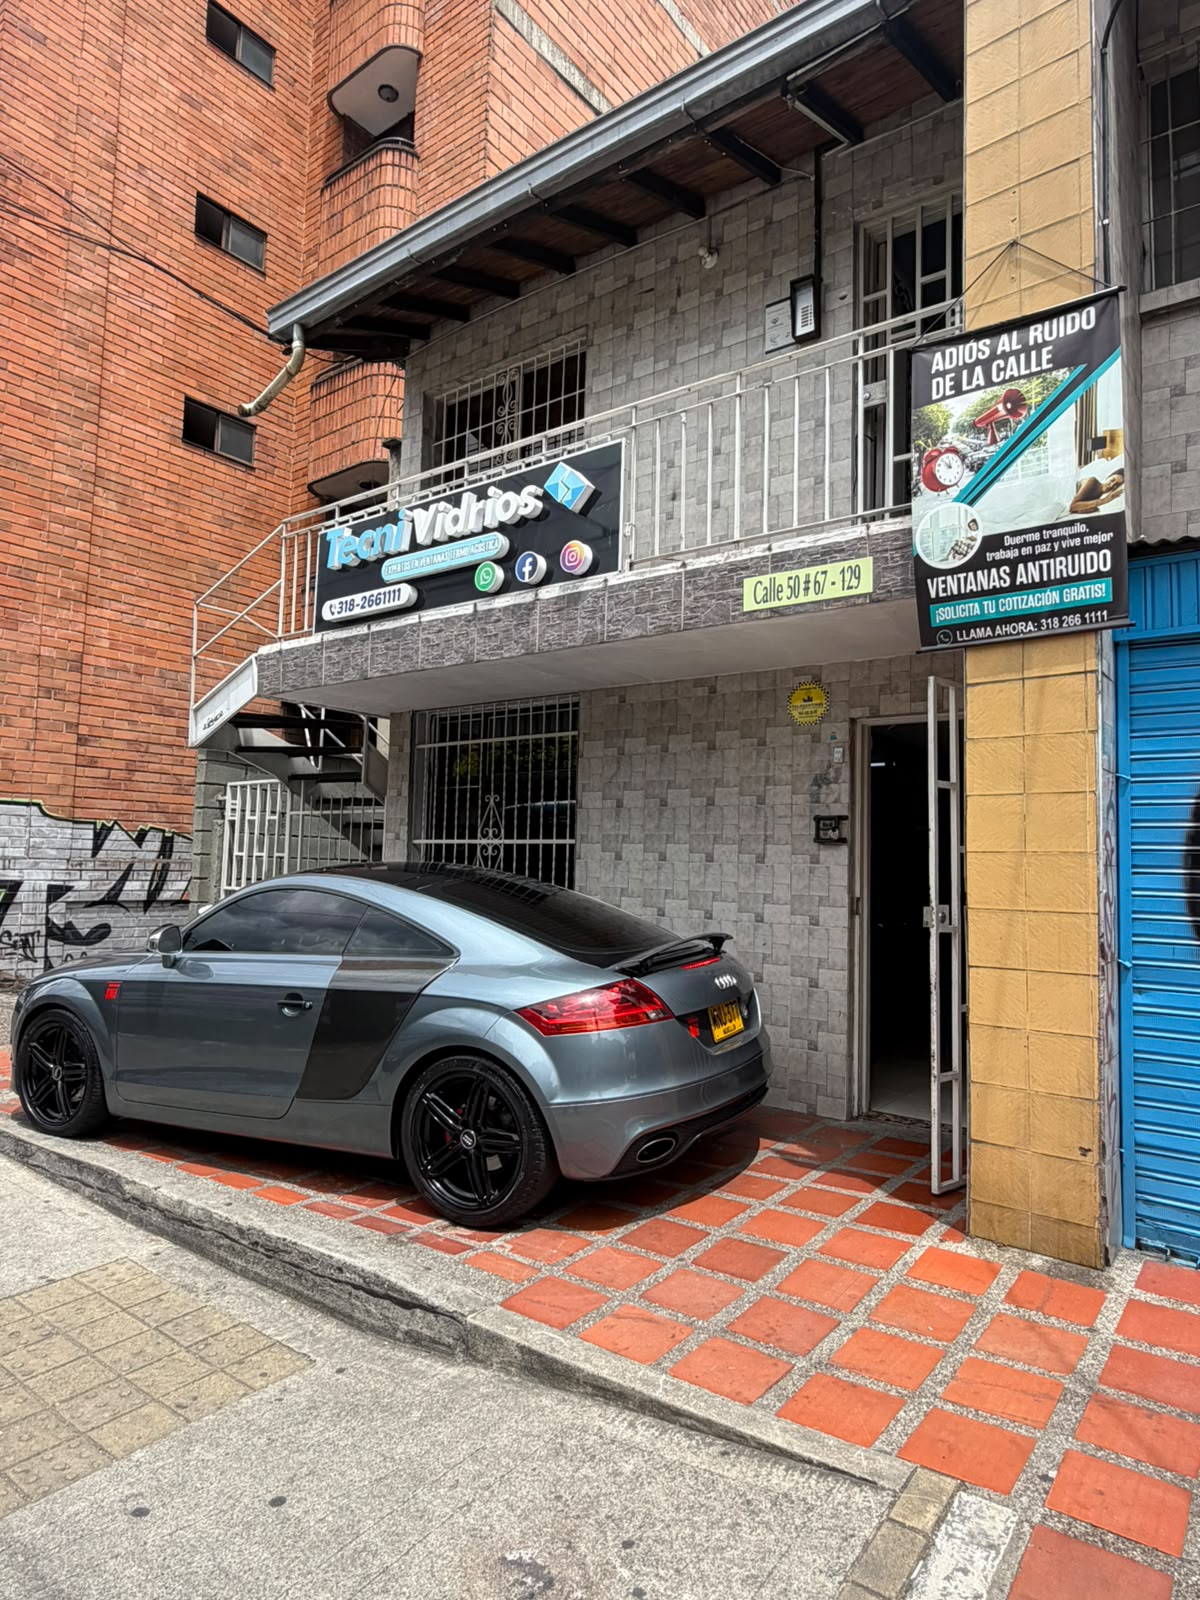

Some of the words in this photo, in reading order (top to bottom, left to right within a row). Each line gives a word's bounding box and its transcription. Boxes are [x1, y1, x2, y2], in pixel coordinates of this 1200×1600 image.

[996, 330, 1022, 355] AL
[1029, 306, 1096, 346] RUIDO
[931, 373, 956, 400] DE
[962, 365, 985, 391] LA
[991, 346, 1053, 383] CALLE
[986, 547, 1019, 562] trabaja
[1021, 545, 1032, 555] en
[1035, 542, 1051, 554] paz
[1054, 540, 1060, 552] y
[1061, 536, 1081, 549] vive
[1083, 531, 1114, 545] mejor
[1004, 531, 1040, 547] Duerme
[1043, 522, 1090, 539] tranquilo,
[753, 576, 784, 605] Calle
[786, 574, 800, 600] 50
[803, 573, 811, 597] #
[813, 570, 828, 596] 67
[839, 564, 861, 592] 129
[927, 565, 1011, 599] VENTANAS
[1016, 549, 1112, 586] ANTIRUIDO
[336, 587, 401, 615] 318-2661111
[935, 602, 981, 624] ¡SOLICITA
[982, 599, 996, 614] TU
[998, 588, 1060, 612] COTIZACIÓN
[1063, 582, 1106, 603] GRATIS!
[956, 626, 993, 641] LLAMA
[994, 620, 1038, 637] AHORA:
[1040, 616, 1060, 630] 318
[1062, 613, 1082, 628] 266
[1084, 609, 1108, 624] 1111
